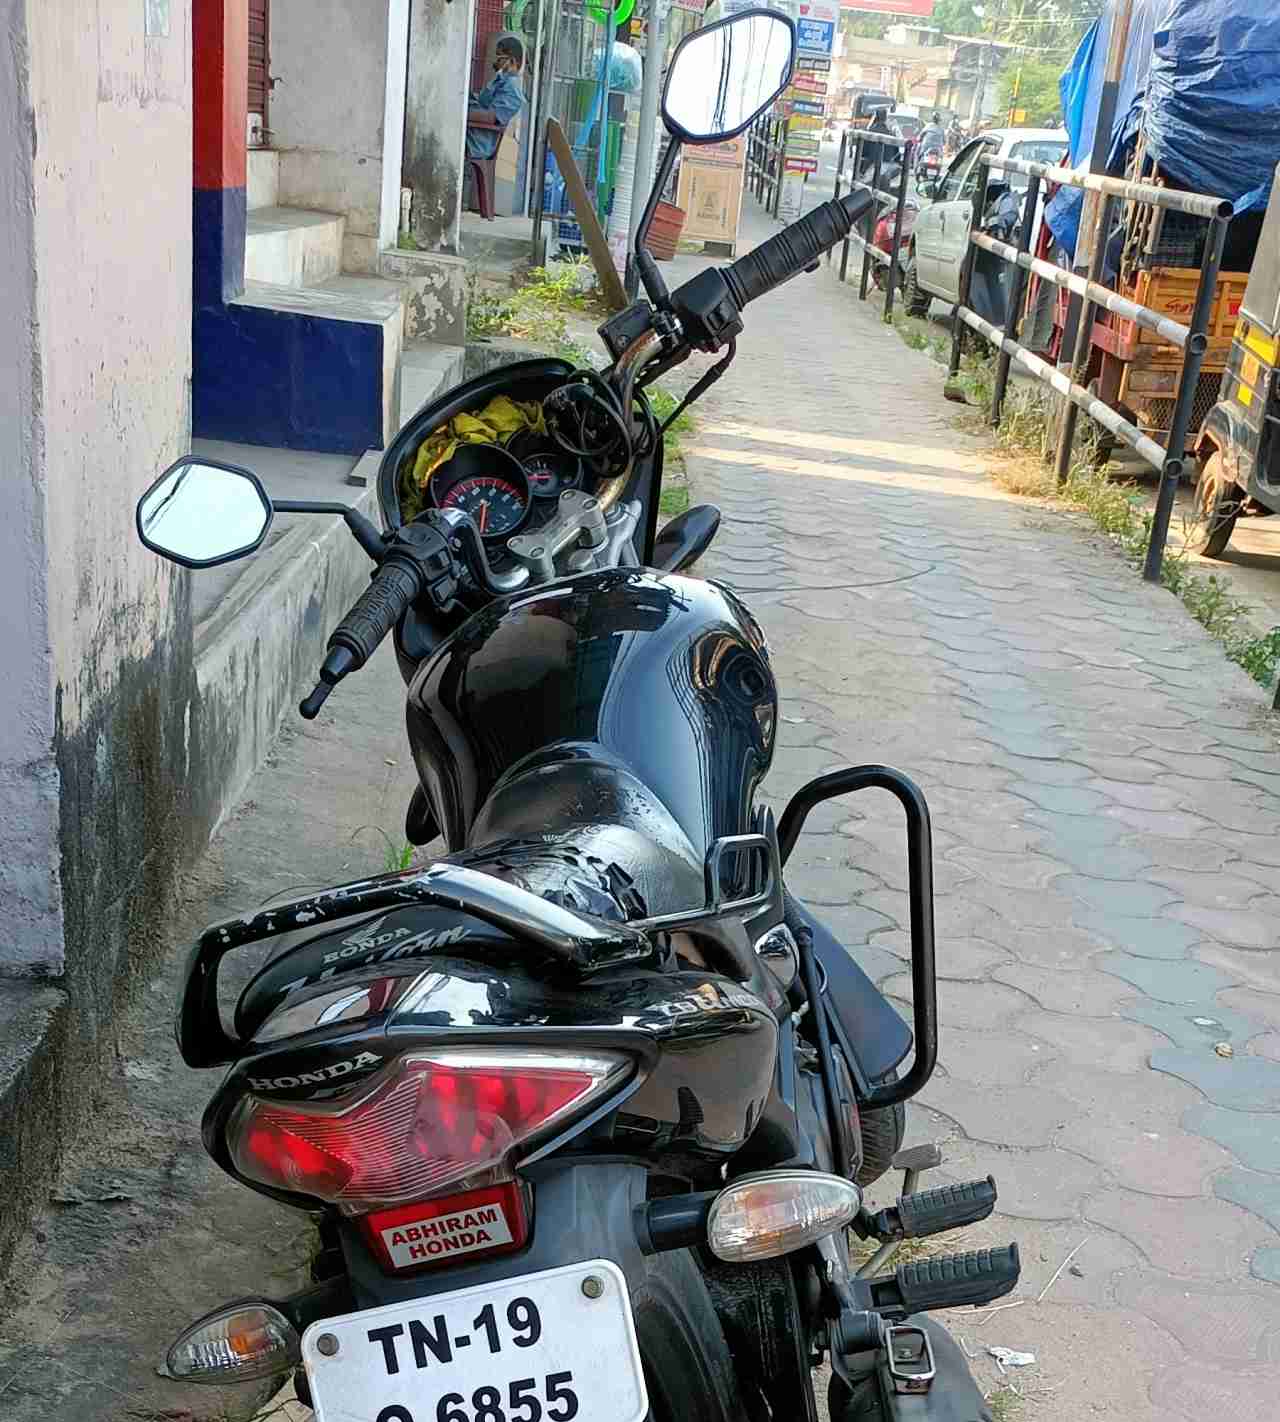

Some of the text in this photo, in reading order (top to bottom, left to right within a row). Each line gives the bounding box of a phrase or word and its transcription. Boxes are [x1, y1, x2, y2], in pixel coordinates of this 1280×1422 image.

[322, 927, 412, 965] HONDA
[248, 1051, 384, 1090] HONDA
[391, 1208, 498, 1247] ABHIRAM
[408, 1229, 492, 1260] HONDA
[367, 1296, 542, 1375] TN-19
